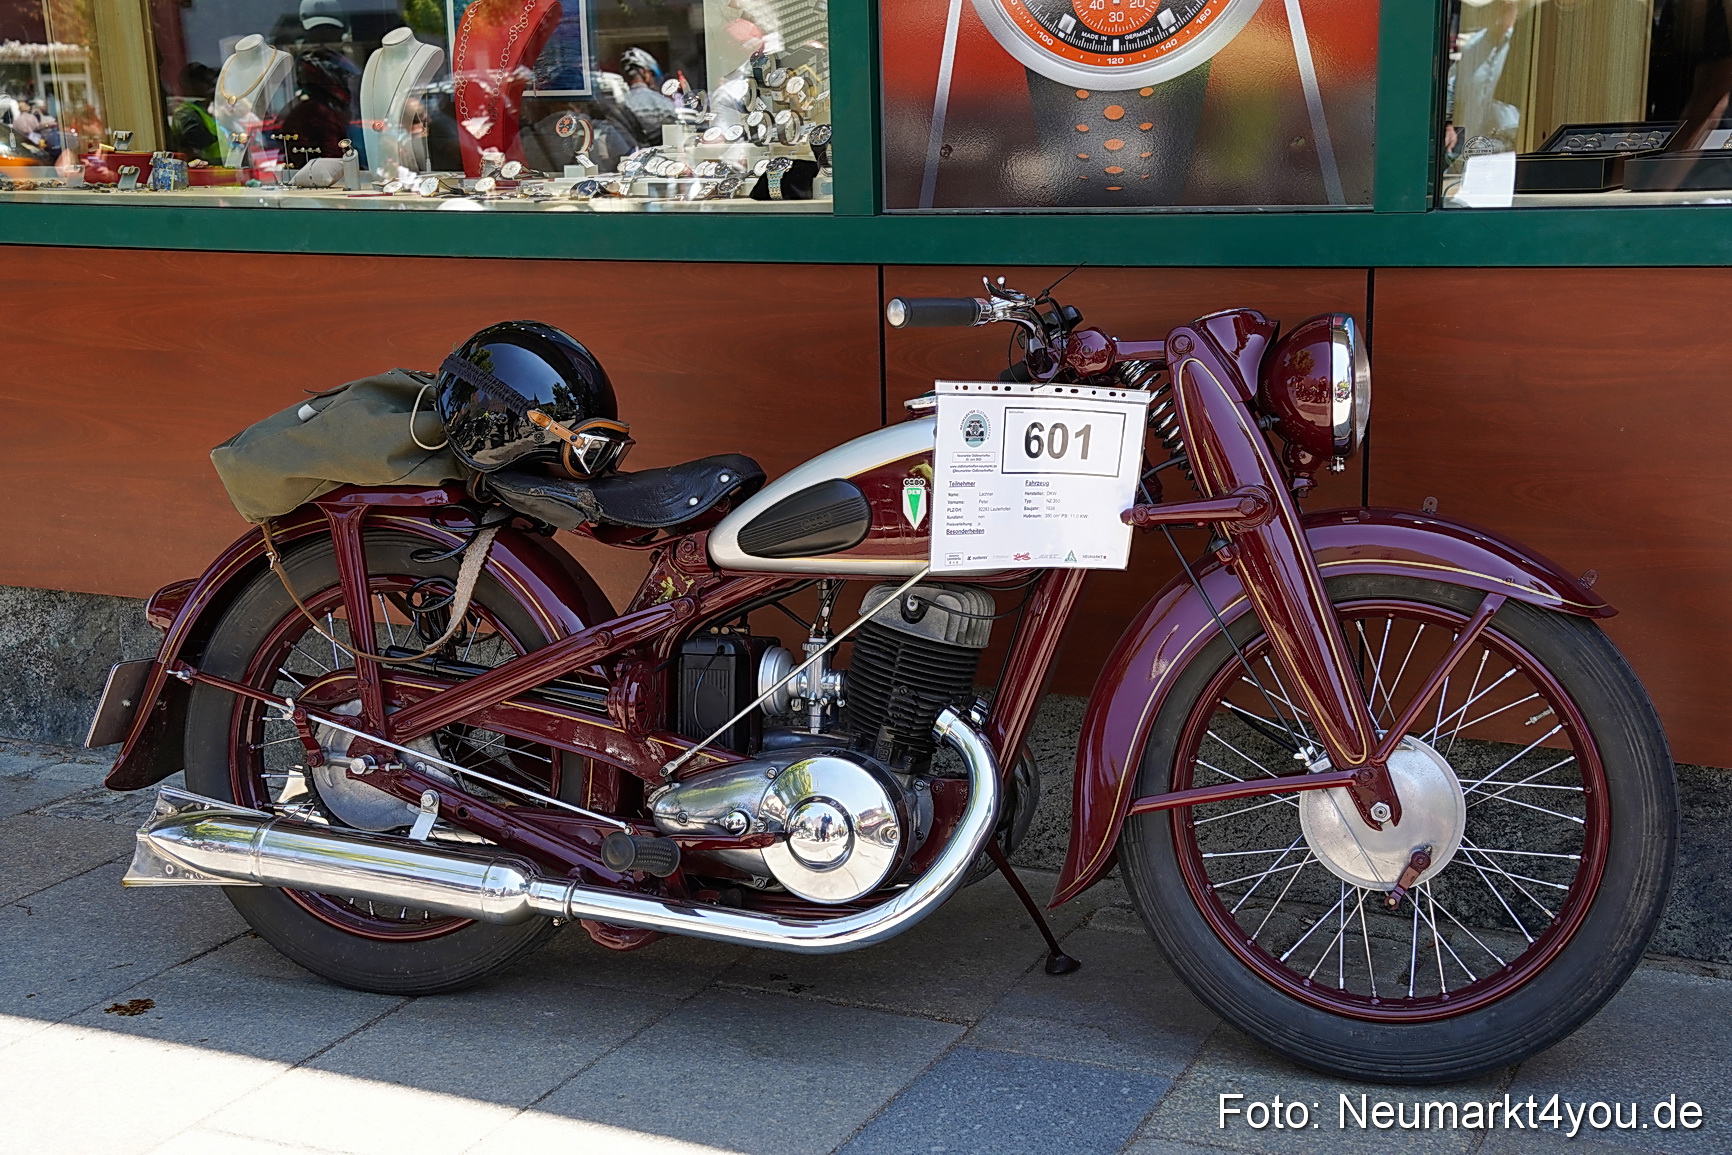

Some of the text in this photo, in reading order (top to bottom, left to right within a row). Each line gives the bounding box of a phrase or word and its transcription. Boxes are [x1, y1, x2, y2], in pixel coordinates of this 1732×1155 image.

[1089, 0, 1105, 10] 40
[1129, 0, 1146, 8] 20
[1108, 12, 1124, 22] 30
[1195, 8, 1212, 25] 160
[1039, 31, 1054, 46] 100
[1080, 31, 1100, 41] MADE
[1124, 27, 1154, 41] GERMANY
[1160, 38, 1178, 52] 140
[1106, 57, 1124, 65] 120
[1024, 421, 1092, 460] 601
